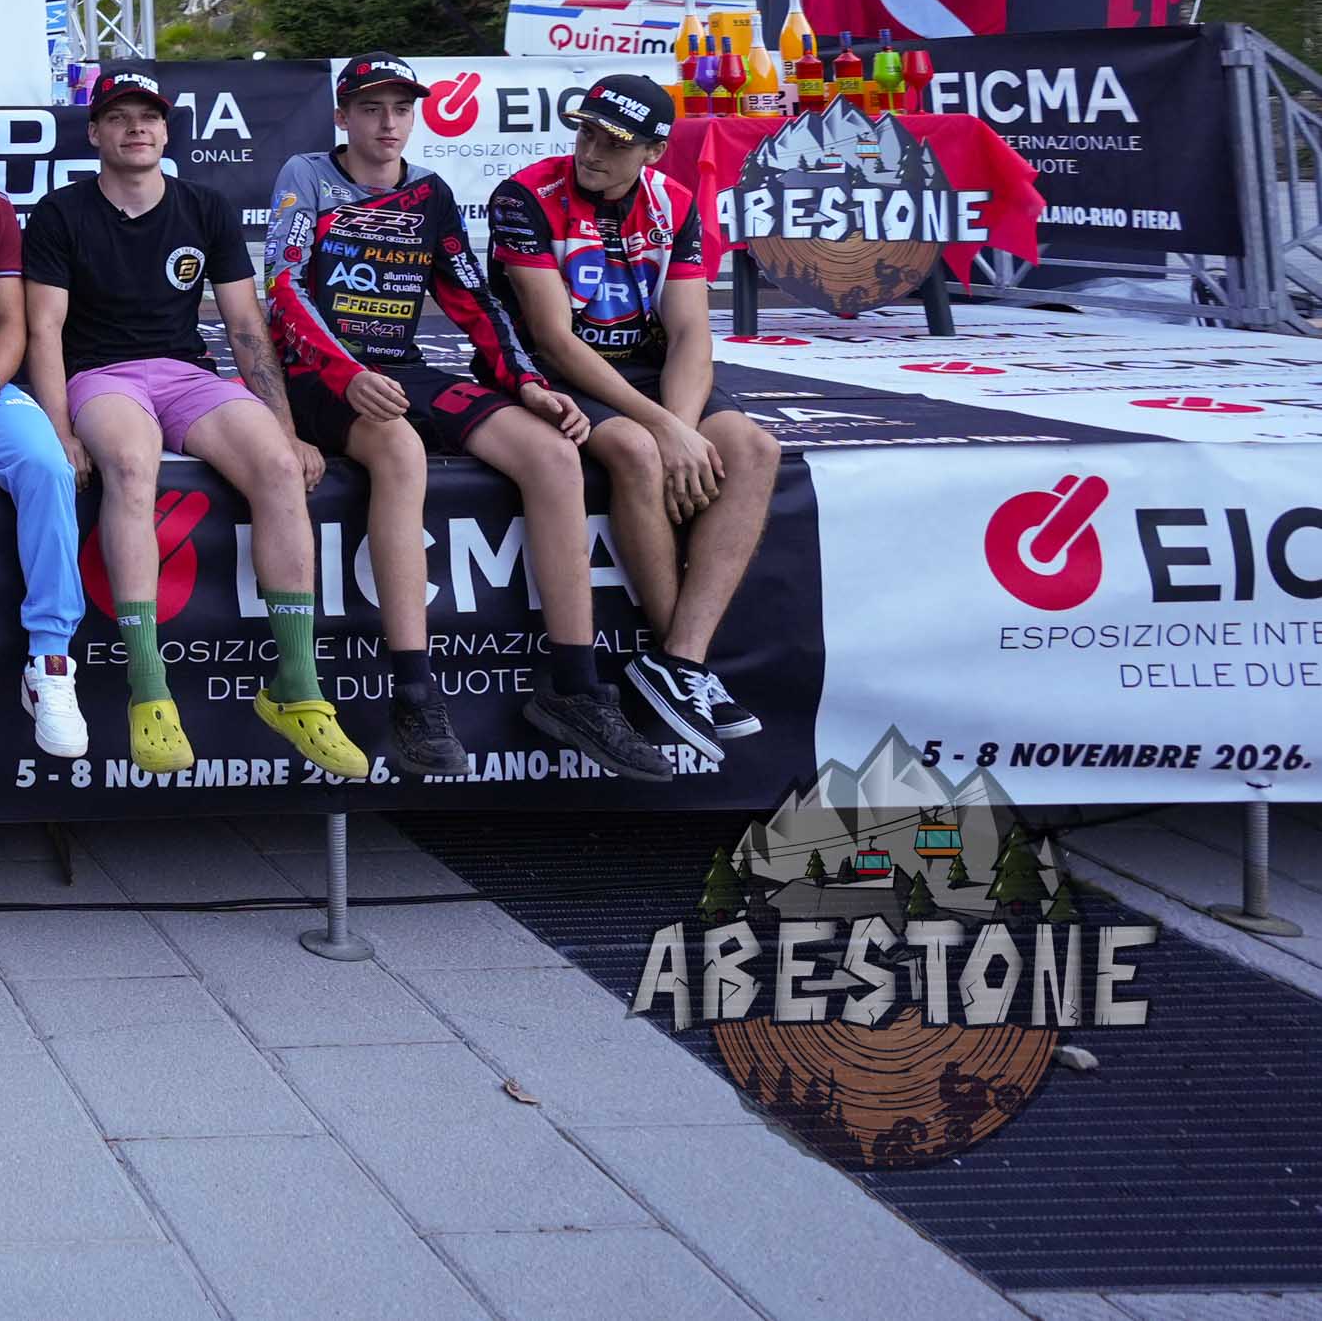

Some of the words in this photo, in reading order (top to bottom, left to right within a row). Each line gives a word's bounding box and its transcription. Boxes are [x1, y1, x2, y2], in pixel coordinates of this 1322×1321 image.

[602, 90, 651, 116] PLEWS
[423, 143, 544, 158] ESPOSIZIONE
[1132, 209, 1183, 231] FIERA
[321, 240, 361, 258] NEW
[364, 246, 433, 266] PLASTIC
[326, 261, 380, 294] AQ
[382, 282, 392, 291] di
[391, 283, 422, 295] qualità
[383, 271, 424, 283] alluminio
[349, 298, 412, 316] FRESCO
[366, 344, 406, 357] inenergy
[999, 622, 1242, 650] ESPOSIZIONE
[1120, 663, 1234, 688] DELLE
[1245, 662, 1322, 687] DUE
[920, 740, 941, 768] 5
[976, 742, 997, 768] 8
[1009, 742, 1202, 770] NOVEMBRE
[1209, 743, 1312, 770] 2026.
[14, 759, 36, 788] 5
[71, 758, 93, 787] 8
